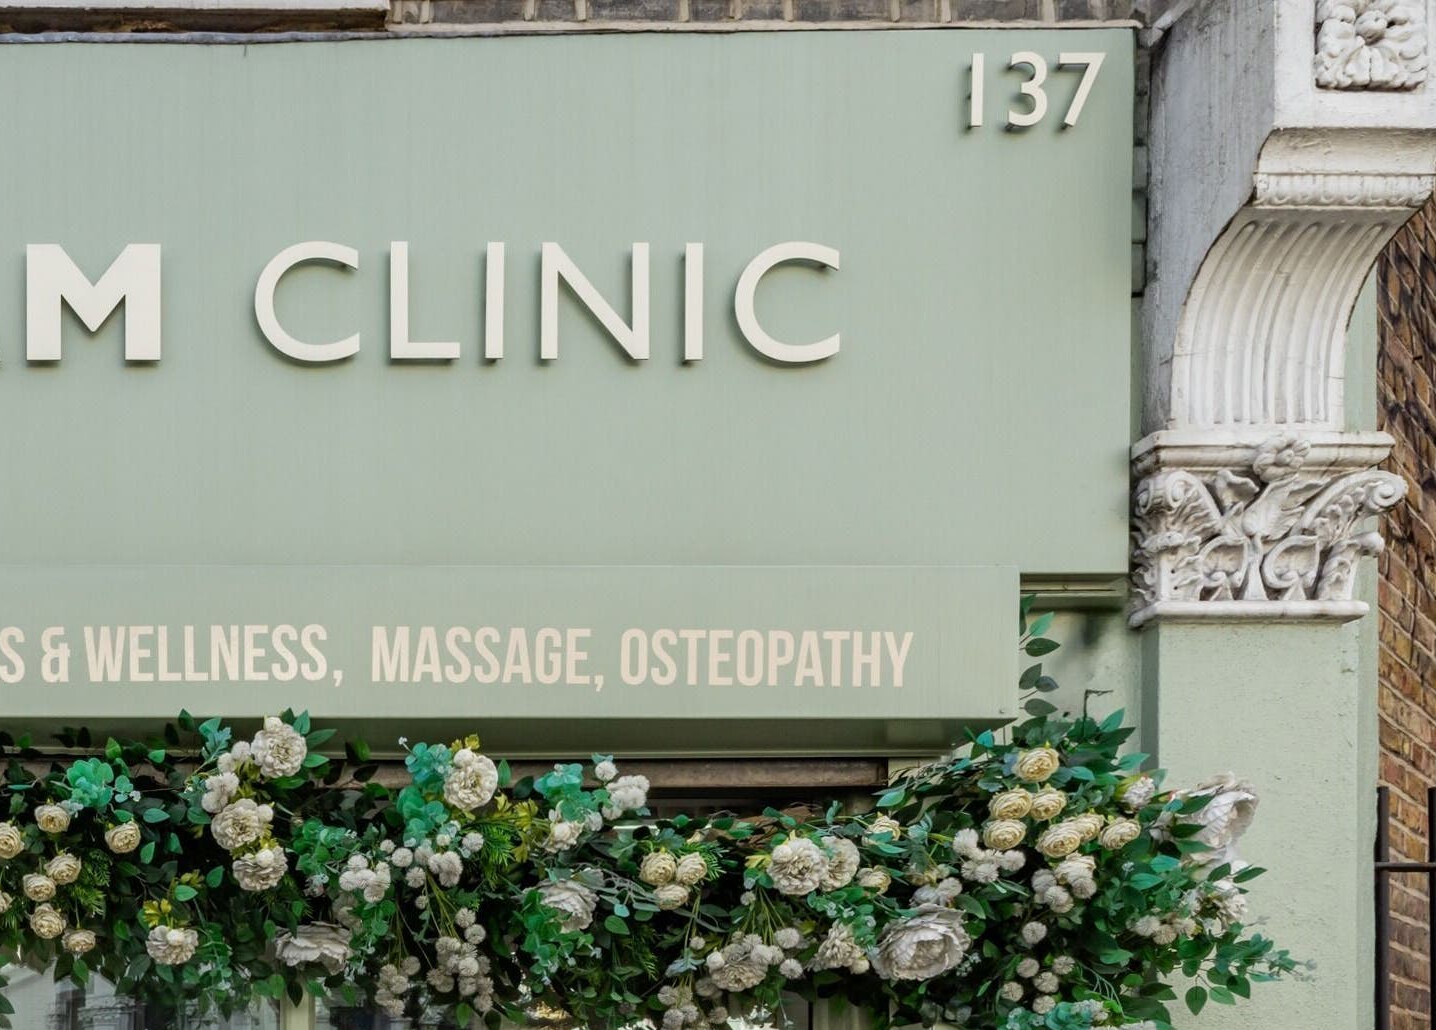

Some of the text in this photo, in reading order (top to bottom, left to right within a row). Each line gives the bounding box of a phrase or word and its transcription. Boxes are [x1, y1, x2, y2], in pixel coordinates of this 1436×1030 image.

[969, 51, 1106, 128] 137
[254, 240, 841, 363] CLINIC
[40, 628, 70, 684] &
[83, 624, 344, 688] WELLNESS,
[372, 627, 605, 693] MASSAGE,
[619, 628, 914, 688] OSTEOPATHY
